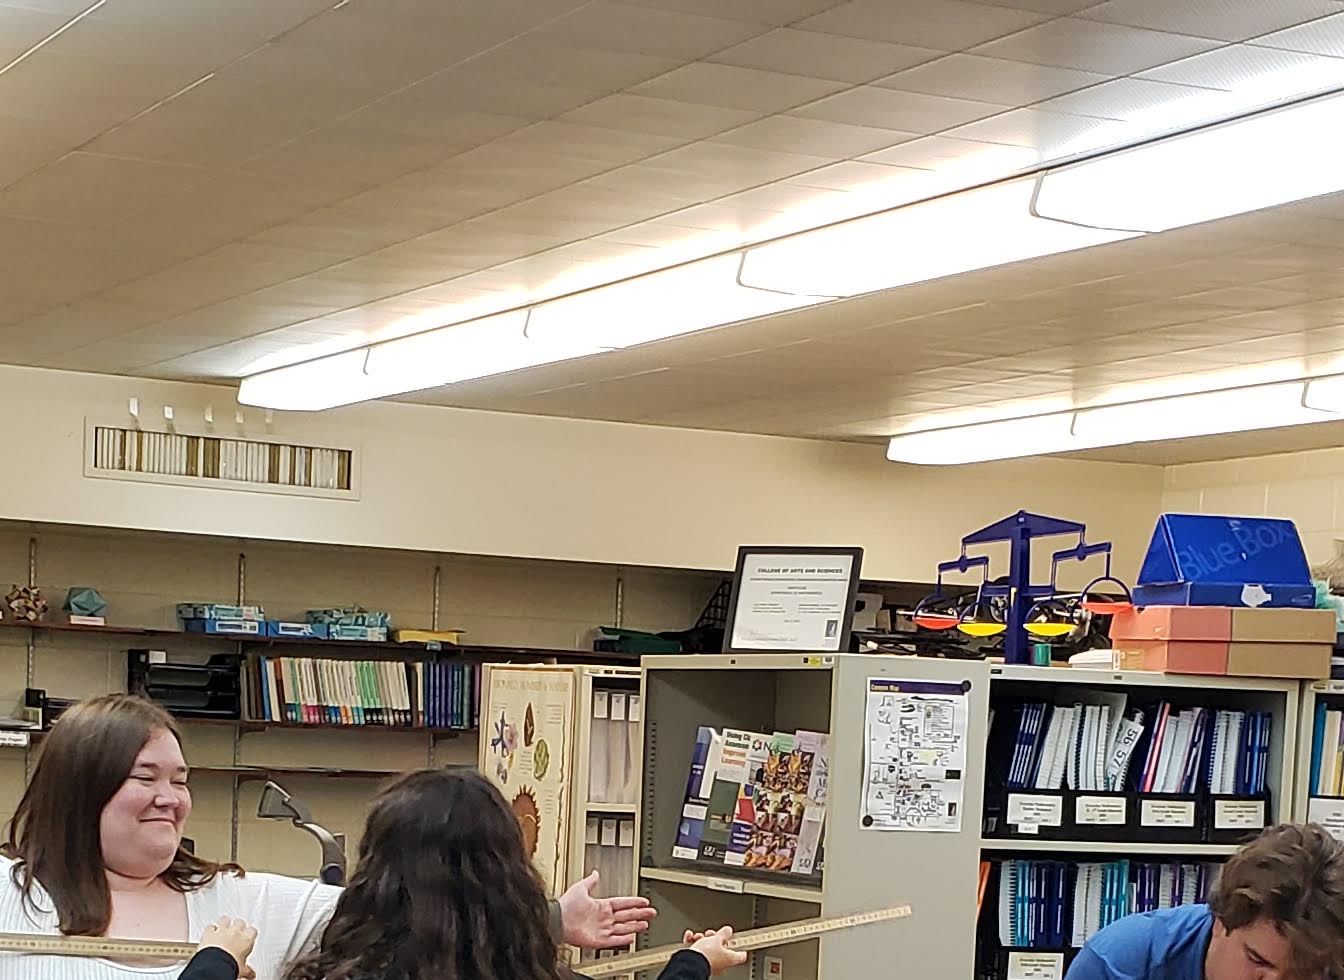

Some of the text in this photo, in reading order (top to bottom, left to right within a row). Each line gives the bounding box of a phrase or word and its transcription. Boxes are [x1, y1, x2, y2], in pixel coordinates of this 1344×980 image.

[1178, 519, 1295, 580] Blue Box
[1123, 728, 1138, 746] 56
[1113, 749, 1127, 768] 57
